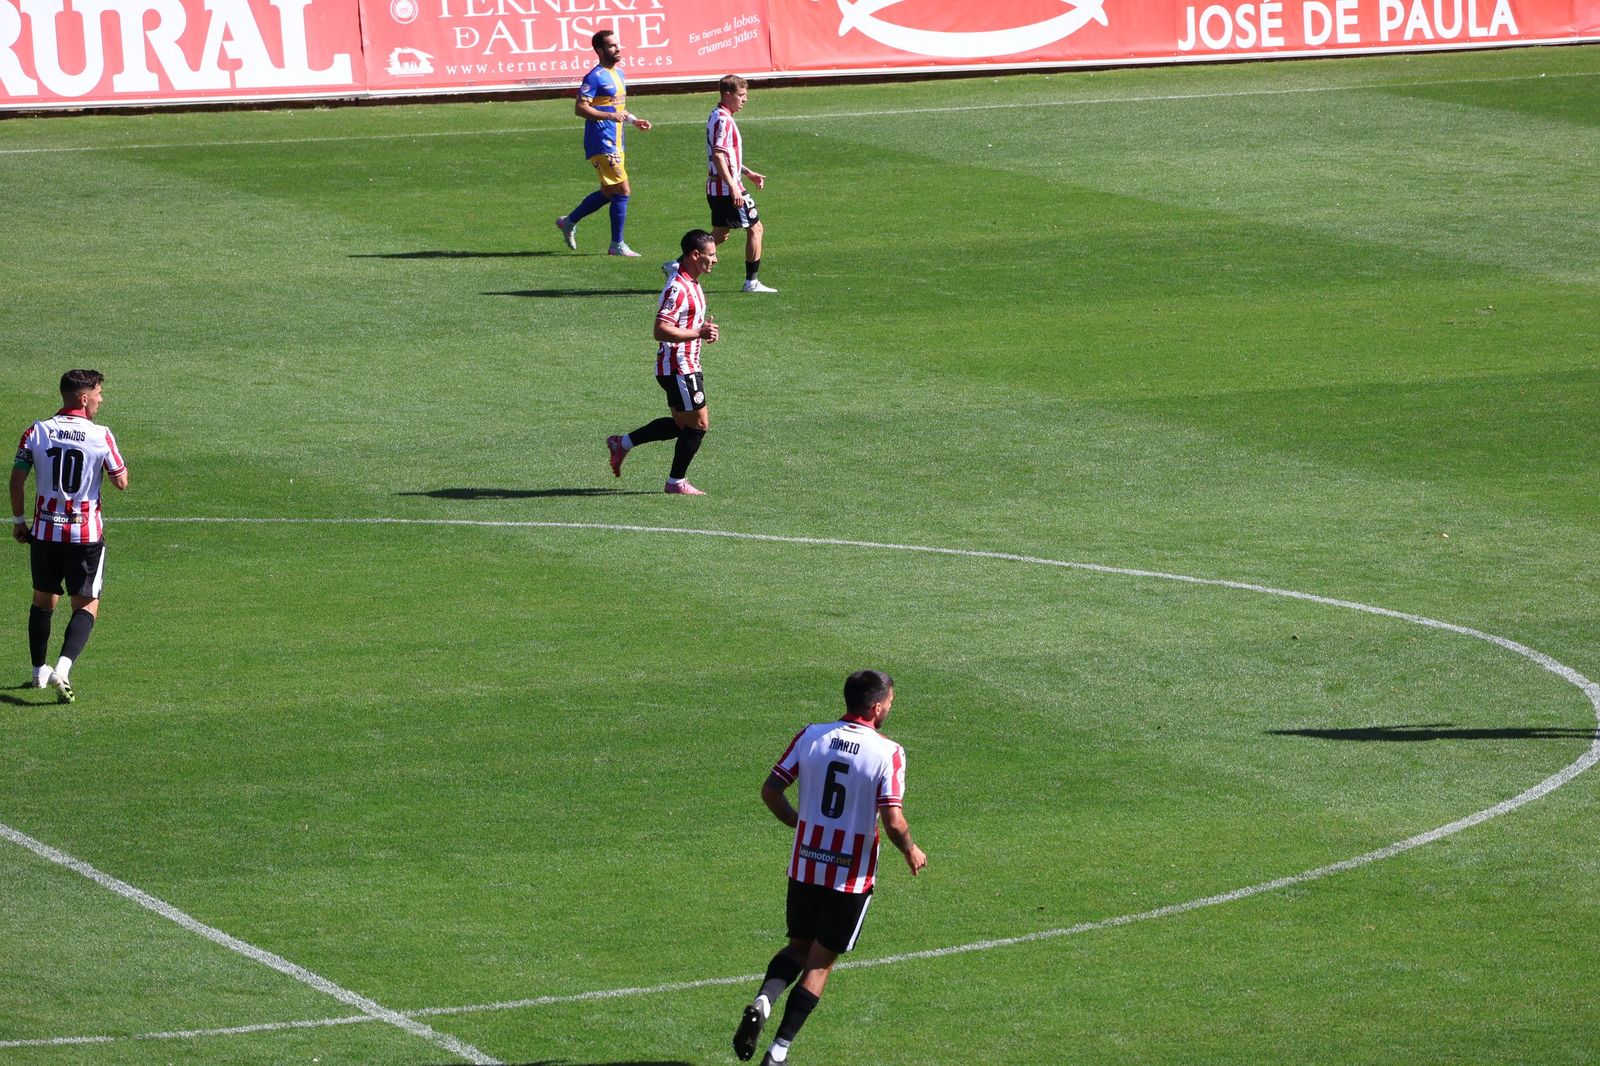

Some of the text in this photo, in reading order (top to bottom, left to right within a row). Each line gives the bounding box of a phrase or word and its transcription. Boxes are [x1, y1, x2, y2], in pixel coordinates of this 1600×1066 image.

[482, 12, 670, 55] ALISTE
[688, 32, 701, 43] En
[702, 28, 722, 40] tierra
[723, 22, 732, 33] de
[697, 28, 758, 56] criamos jatos
[1177, 0, 1519, 51] JOSÉ DE PAULA
[445, 54, 673, 75] www.terneradeaste.es
[45, 446, 85, 494] 10
[829, 735, 861, 756] MARIO
[821, 760, 850, 820] 6
